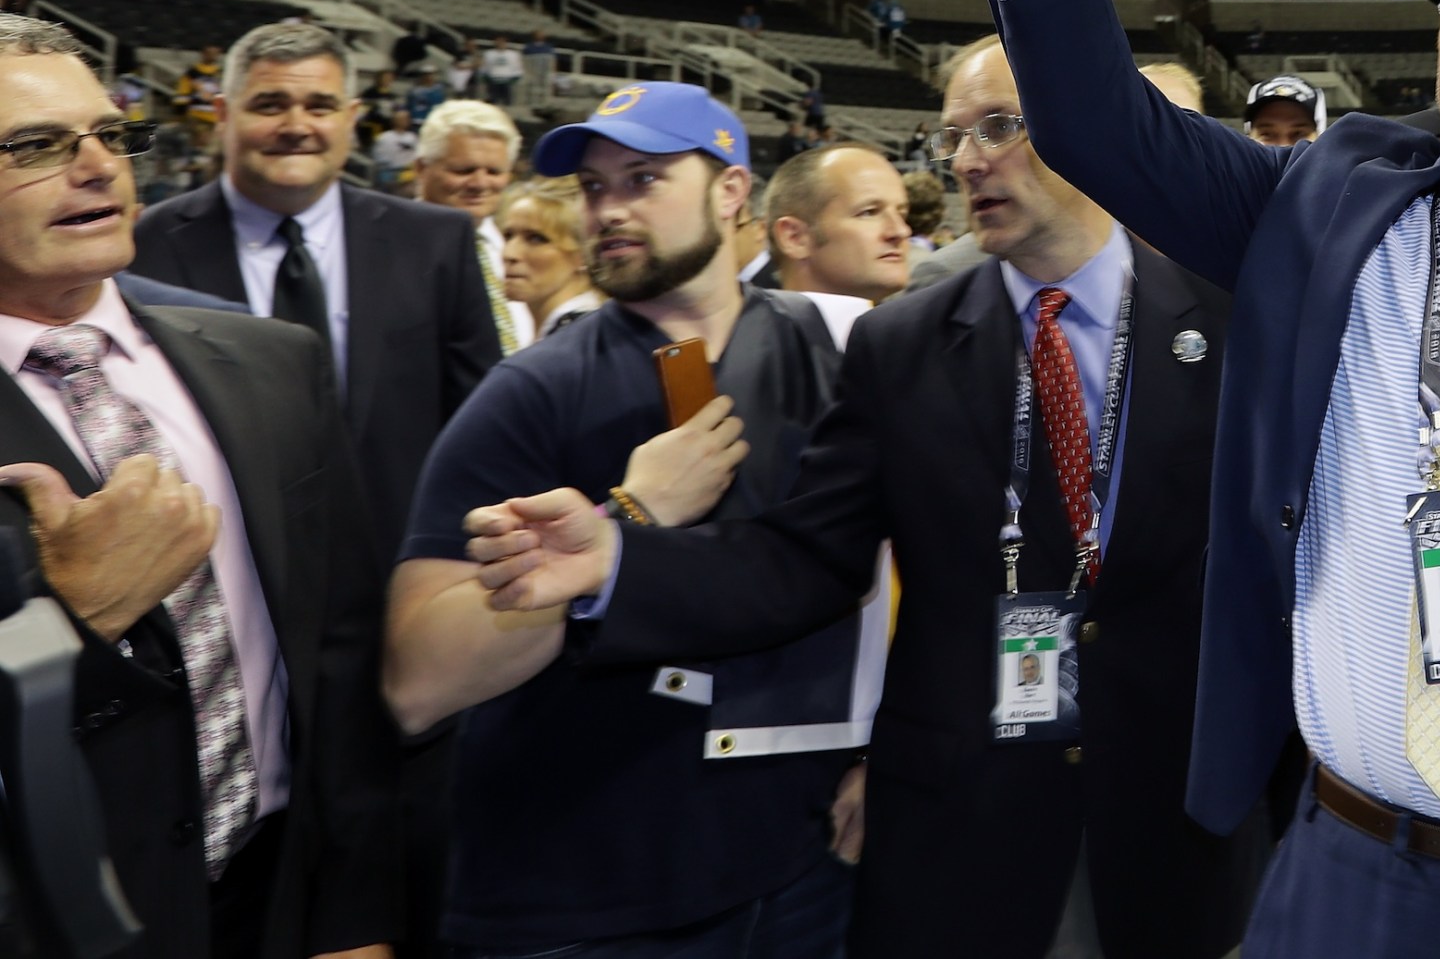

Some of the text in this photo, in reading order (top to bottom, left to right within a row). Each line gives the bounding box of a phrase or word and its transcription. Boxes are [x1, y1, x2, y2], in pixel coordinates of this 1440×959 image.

[1108, 334, 1128, 379] FINAL
[1017, 375, 1030, 420] FINAL
[1106, 379, 1122, 407] CUP
[1097, 407, 1118, 472] STANLEY
[1004, 612, 1059, 624] FINAL
[1009, 710, 1023, 719] All
[999, 724, 1027, 737] CLUB
